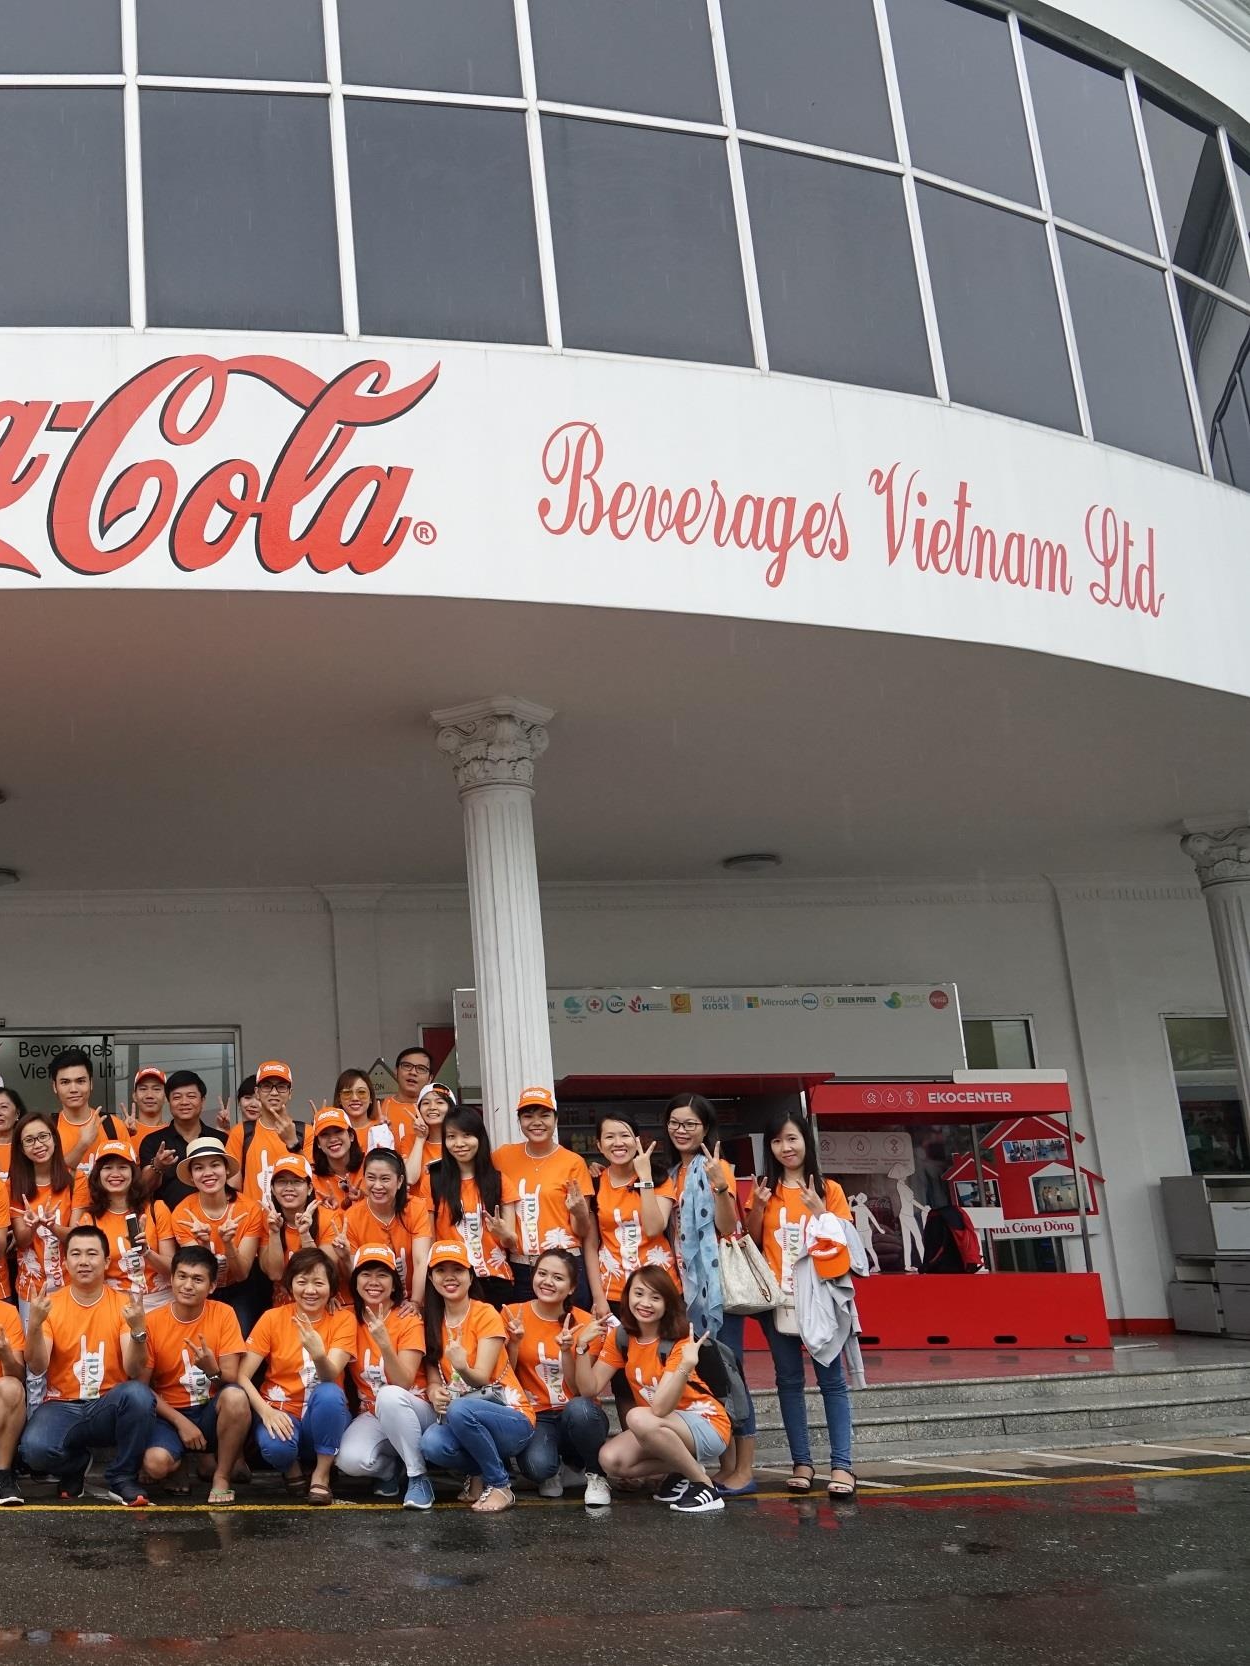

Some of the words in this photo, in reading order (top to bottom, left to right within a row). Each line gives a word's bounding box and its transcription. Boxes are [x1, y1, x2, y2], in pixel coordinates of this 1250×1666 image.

[537, 420, 850, 588] Beverages
[867, 461, 1072, 596] Vietnam
[1085, 504, 1165, 618] Ltd
[761, 998, 800, 1006] Microsoft
[928, 1092, 1012, 1103] EKOCENTER
